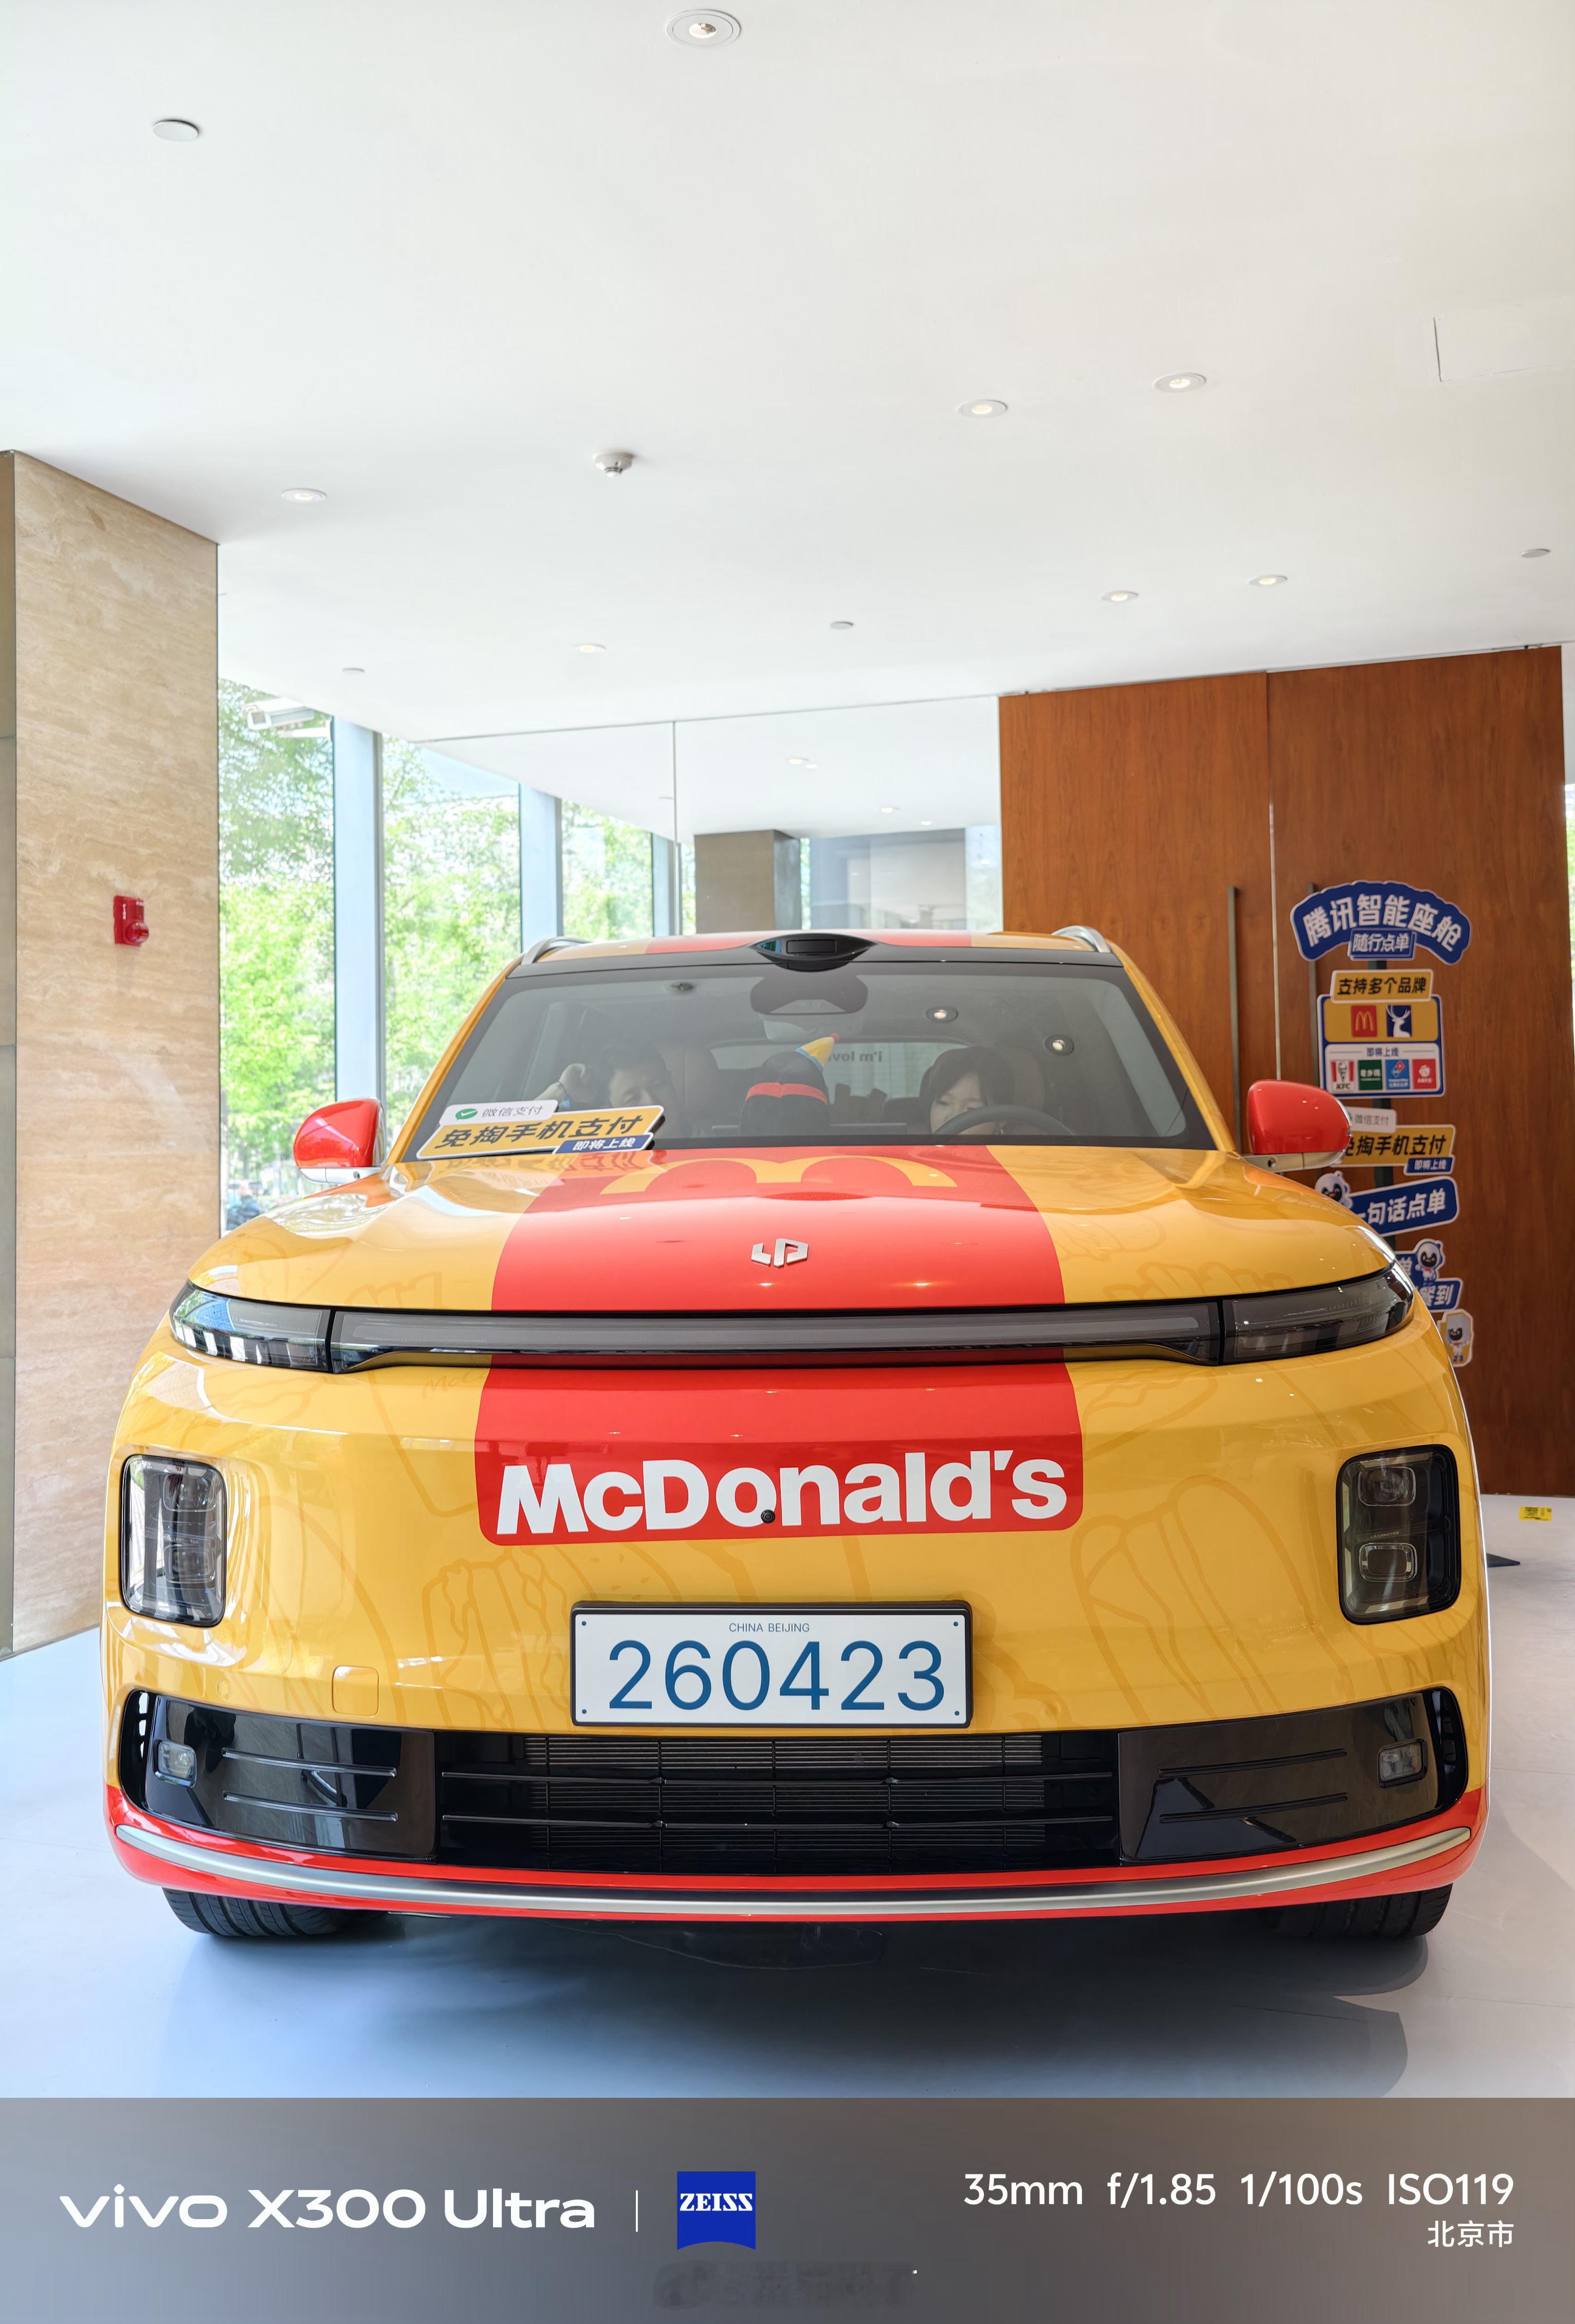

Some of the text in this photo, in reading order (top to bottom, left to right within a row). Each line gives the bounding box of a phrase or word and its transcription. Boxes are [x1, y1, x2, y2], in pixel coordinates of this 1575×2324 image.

[1303, 894, 1462, 952] 腾讯智能座舱
[1352, 933, 1409, 952] 随行点单
[1337, 976, 1426, 995] 支持多个品牌
[1366, 1047, 1399, 1057] 即将上线
[482, 1105, 543, 1118] 微信支付
[1354, 1114, 1389, 1126] 微信支付
[435, 1115, 643, 1149] 免掏手机支付
[573, 1137, 636, 1151] 即将上线
[1414, 1159, 1447, 1171] 即将上线
[497, 1450, 1067, 1535] McDonald's
[729, 1623, 810, 1632] CHINA BEIJING
[609, 1640, 945, 1711] 260423
